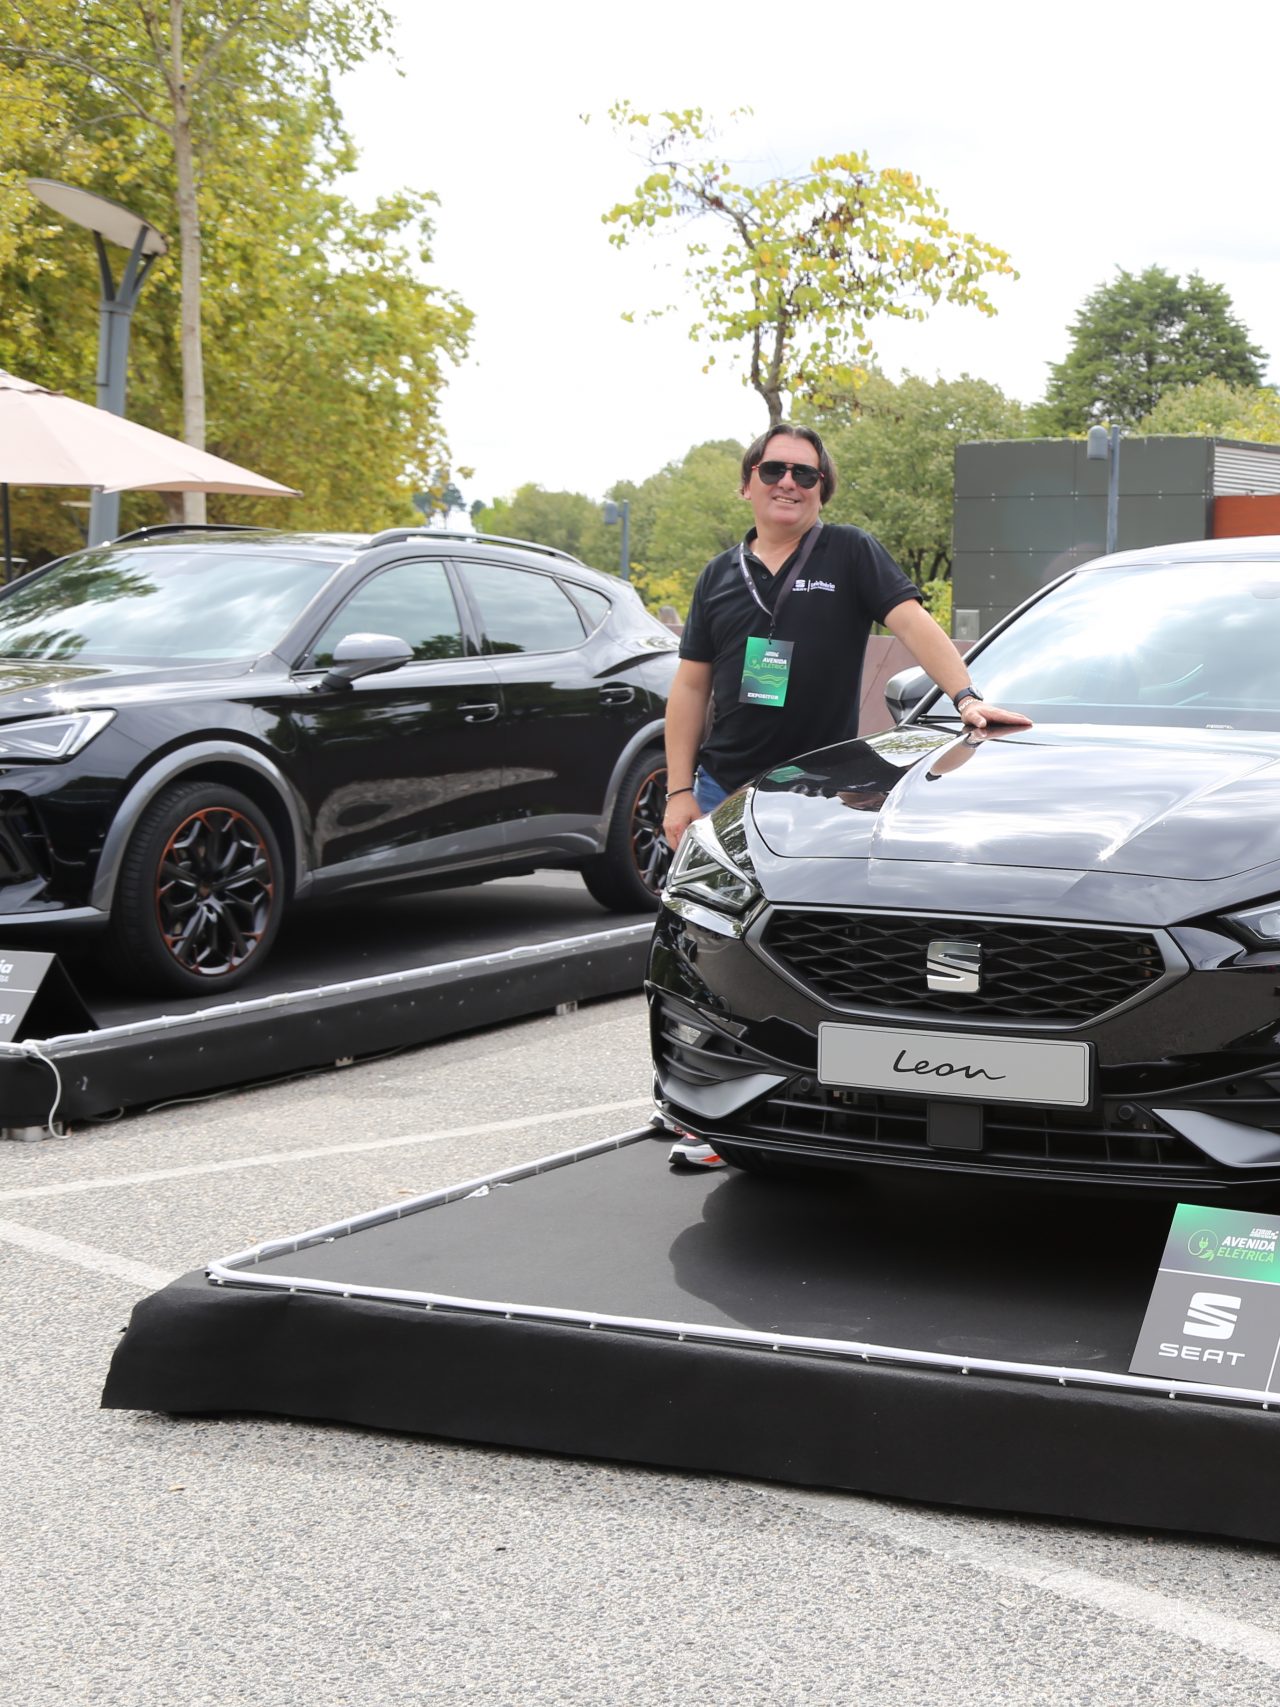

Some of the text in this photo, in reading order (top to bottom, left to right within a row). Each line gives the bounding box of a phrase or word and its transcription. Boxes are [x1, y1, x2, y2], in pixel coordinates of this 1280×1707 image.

[893, 1049, 1006, 1081] Leon
[1221, 1235, 1276, 1252] AVENIDA
[1158, 1342, 1246, 1366] SEAT
